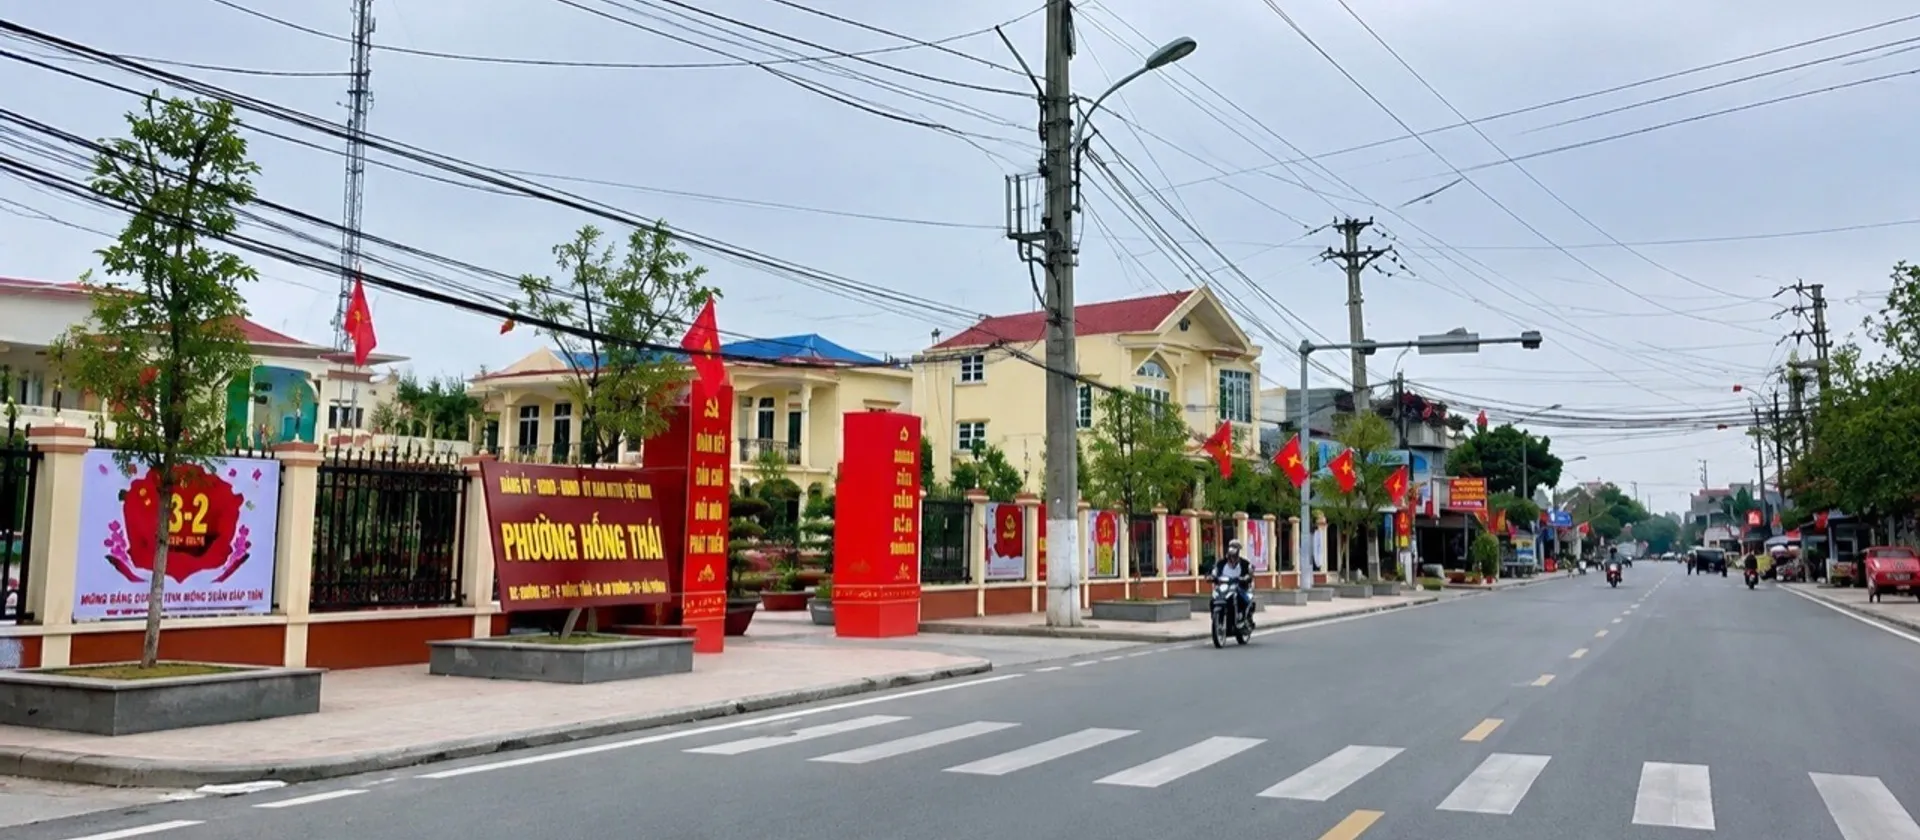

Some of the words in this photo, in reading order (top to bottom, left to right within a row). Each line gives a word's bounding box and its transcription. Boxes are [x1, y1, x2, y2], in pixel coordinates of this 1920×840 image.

[168, 493, 209, 534] 3-2
[501, 512, 578, 561] PHƯỜNG
[579, 511, 627, 561] HỒNG
[627, 517, 664, 560] THÁI
